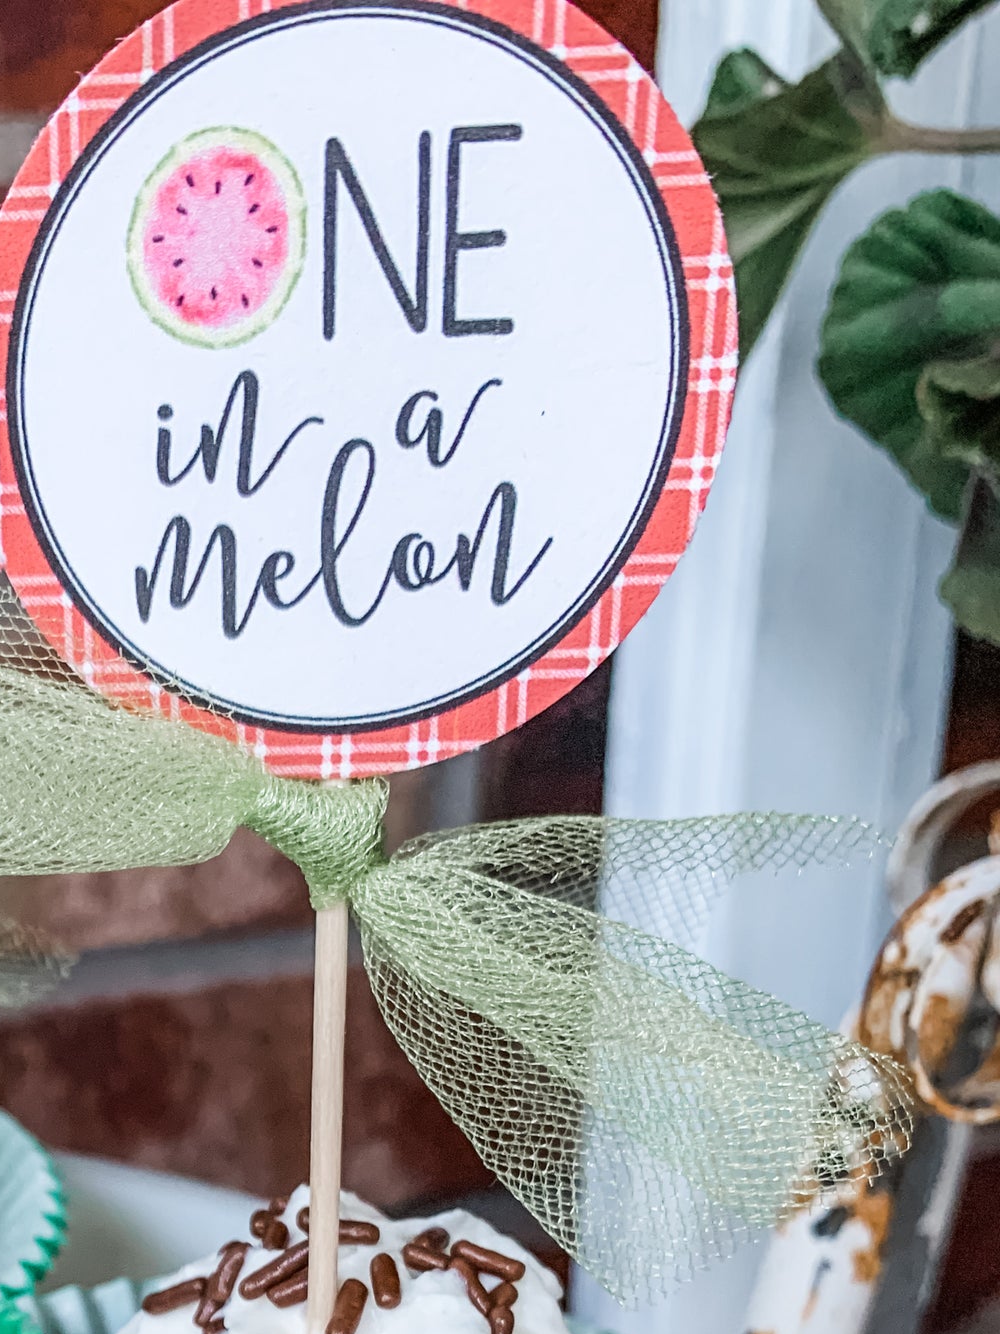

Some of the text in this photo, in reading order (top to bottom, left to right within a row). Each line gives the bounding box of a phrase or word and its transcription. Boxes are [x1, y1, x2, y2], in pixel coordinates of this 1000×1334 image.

[156, 369, 503, 497] in a
[134, 438, 553, 639] melon
